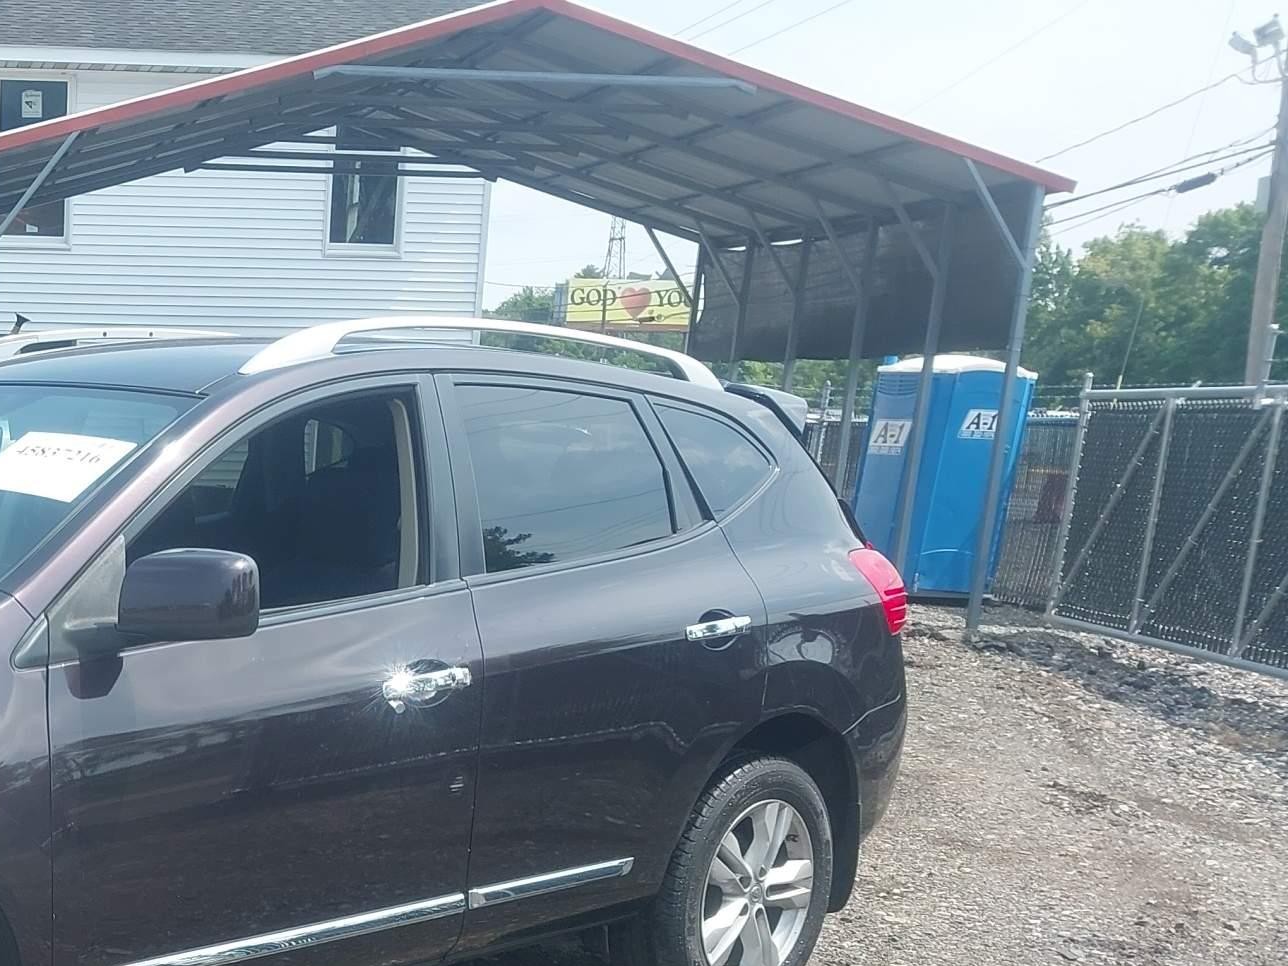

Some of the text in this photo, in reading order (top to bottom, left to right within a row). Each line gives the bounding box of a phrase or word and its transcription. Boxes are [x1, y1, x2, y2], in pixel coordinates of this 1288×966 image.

[570, 287, 617, 306] GOD
[965, 412, 998, 431] A-1
[872, 422, 905, 444] A-1
